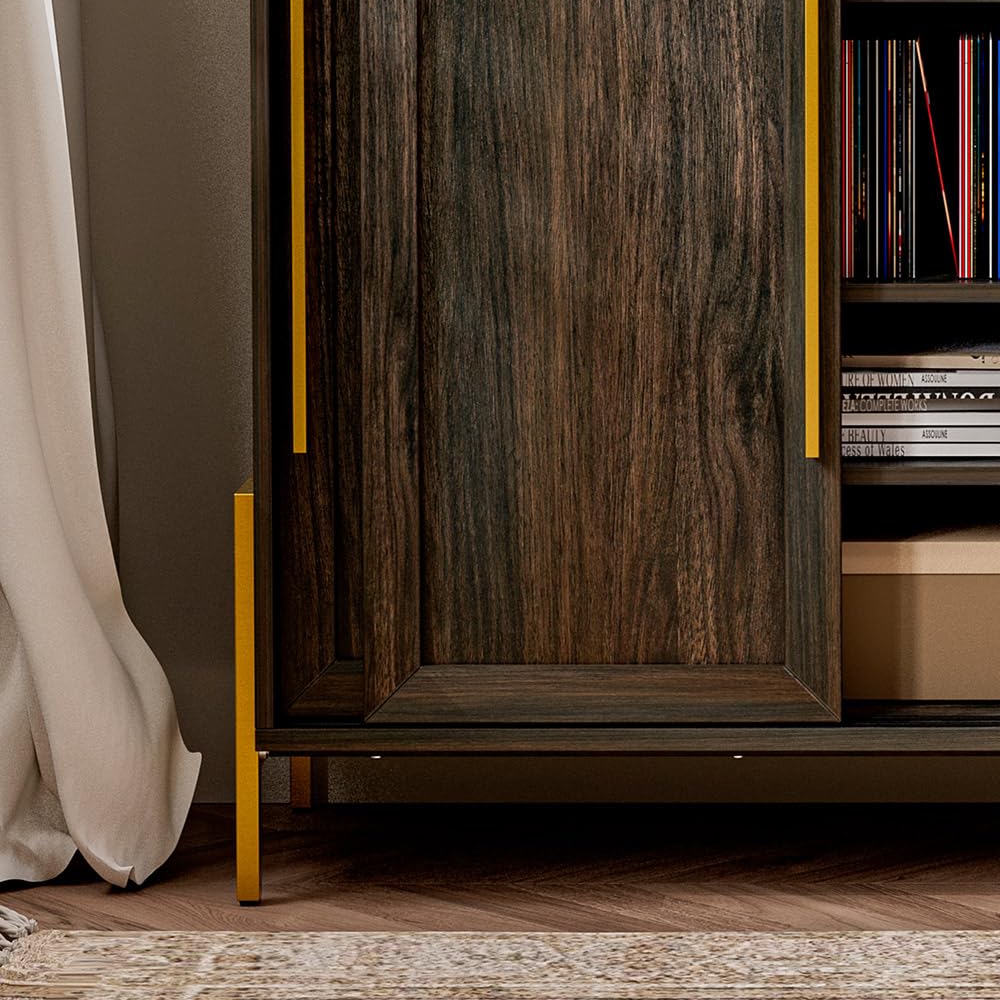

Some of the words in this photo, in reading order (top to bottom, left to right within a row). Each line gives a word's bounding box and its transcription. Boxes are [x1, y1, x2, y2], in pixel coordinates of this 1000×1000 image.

[862, 373, 875, 387] OF
[877, 373, 914, 387] WOMEN
[921, 374, 948, 384] ASSOULINE
[860, 399, 900, 412] COMPLETE
[901, 399, 928, 412] WORKS
[848, 429, 887, 442] BEAUTY
[922, 429, 948, 439] ASSOULINE
[864, 444, 874, 457] of
[877, 443, 905, 457] Wales
